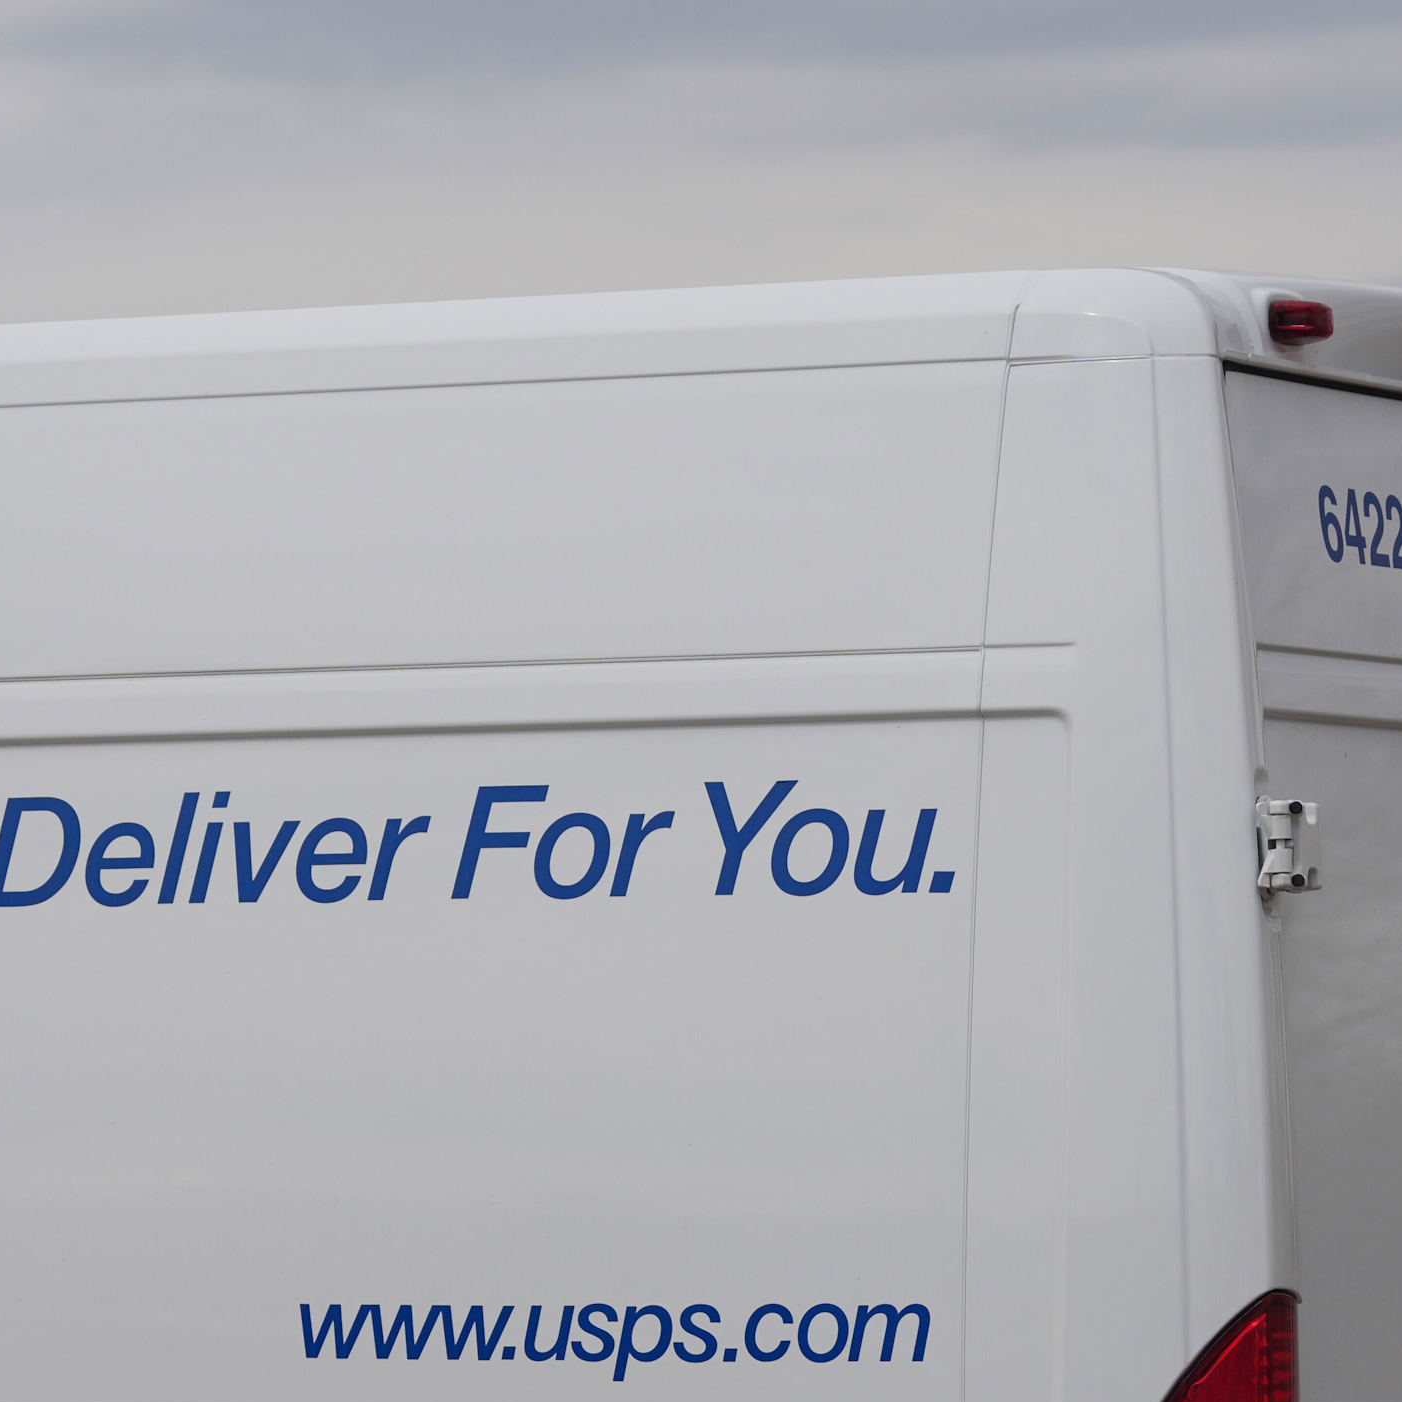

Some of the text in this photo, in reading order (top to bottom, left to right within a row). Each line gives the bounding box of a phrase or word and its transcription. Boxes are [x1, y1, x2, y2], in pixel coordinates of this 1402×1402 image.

[451, 785, 675, 900] For
[704, 780, 957, 897] You.
[300, 1303, 931, 1382] www.usps.com
